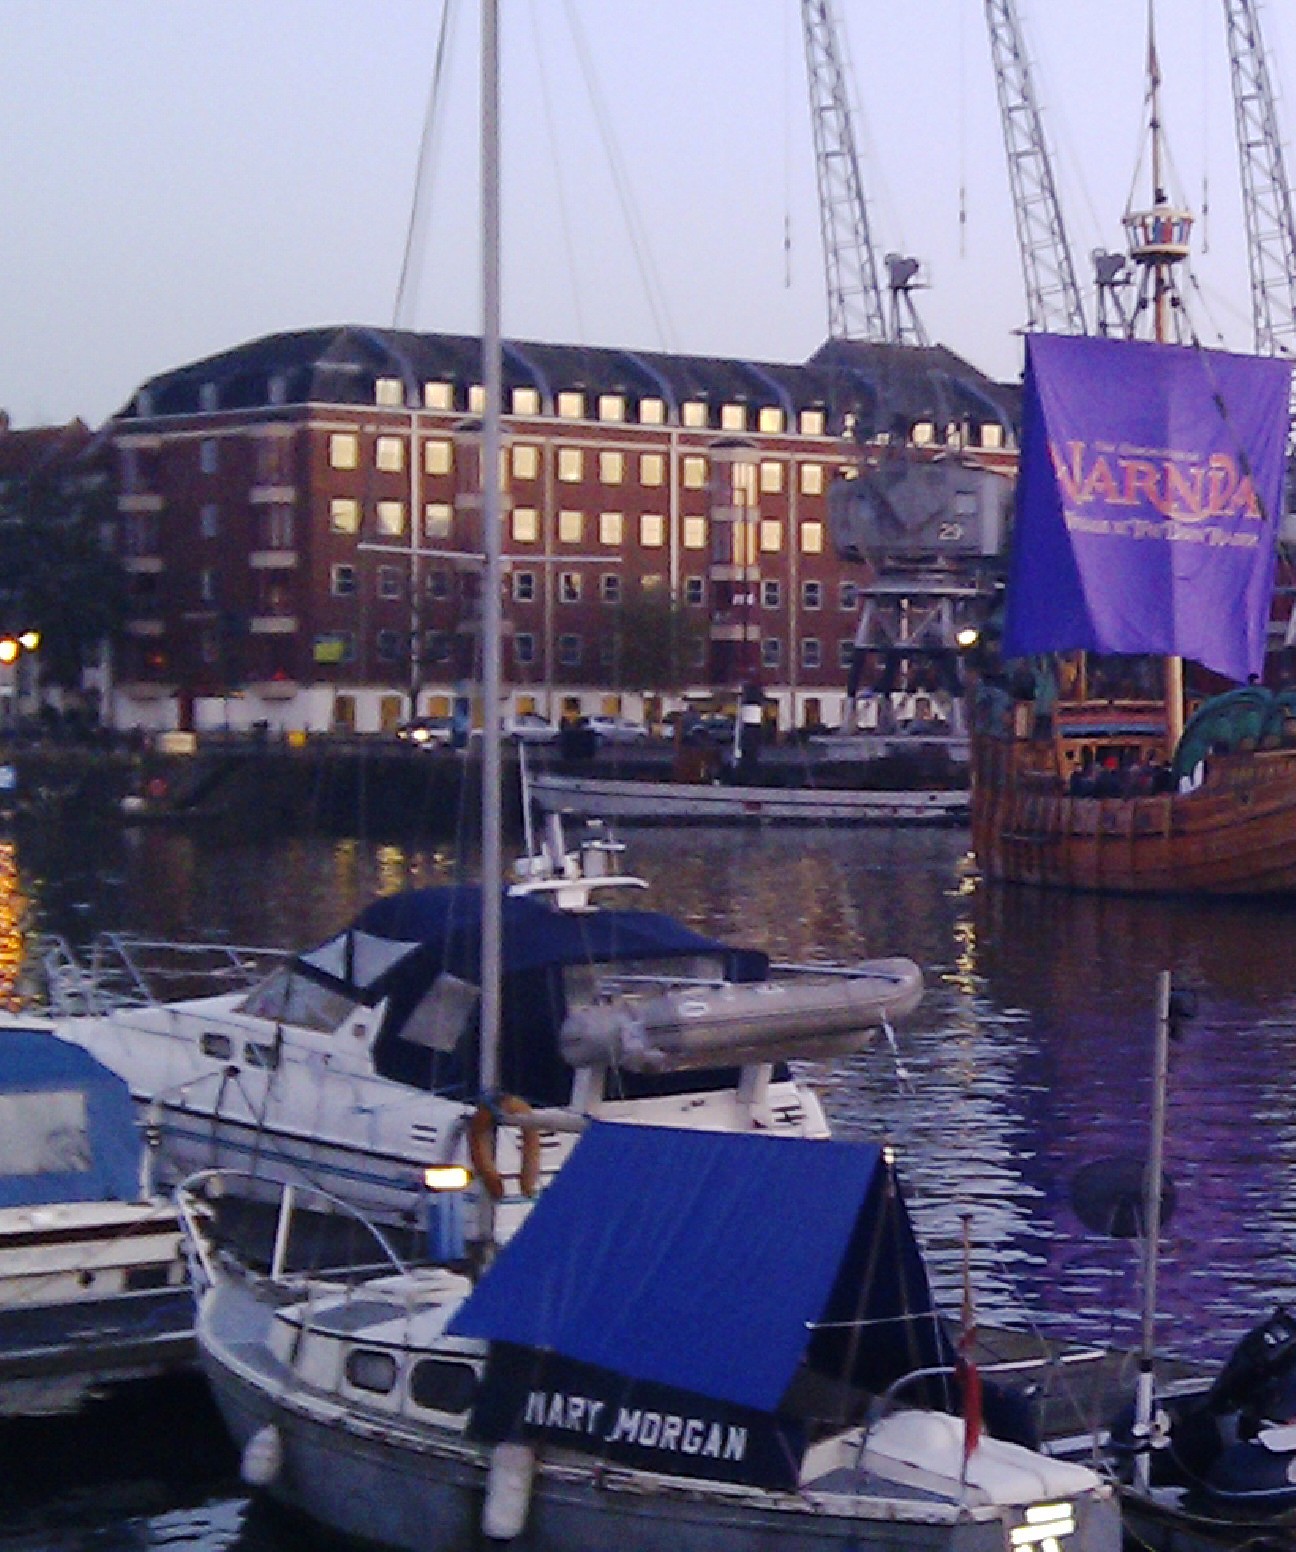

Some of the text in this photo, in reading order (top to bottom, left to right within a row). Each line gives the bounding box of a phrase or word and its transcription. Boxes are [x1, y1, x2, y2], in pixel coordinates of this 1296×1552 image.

[1048, 440, 1261, 522] NARNIA
[523, 1391, 748, 1461] MARY MORGAN
